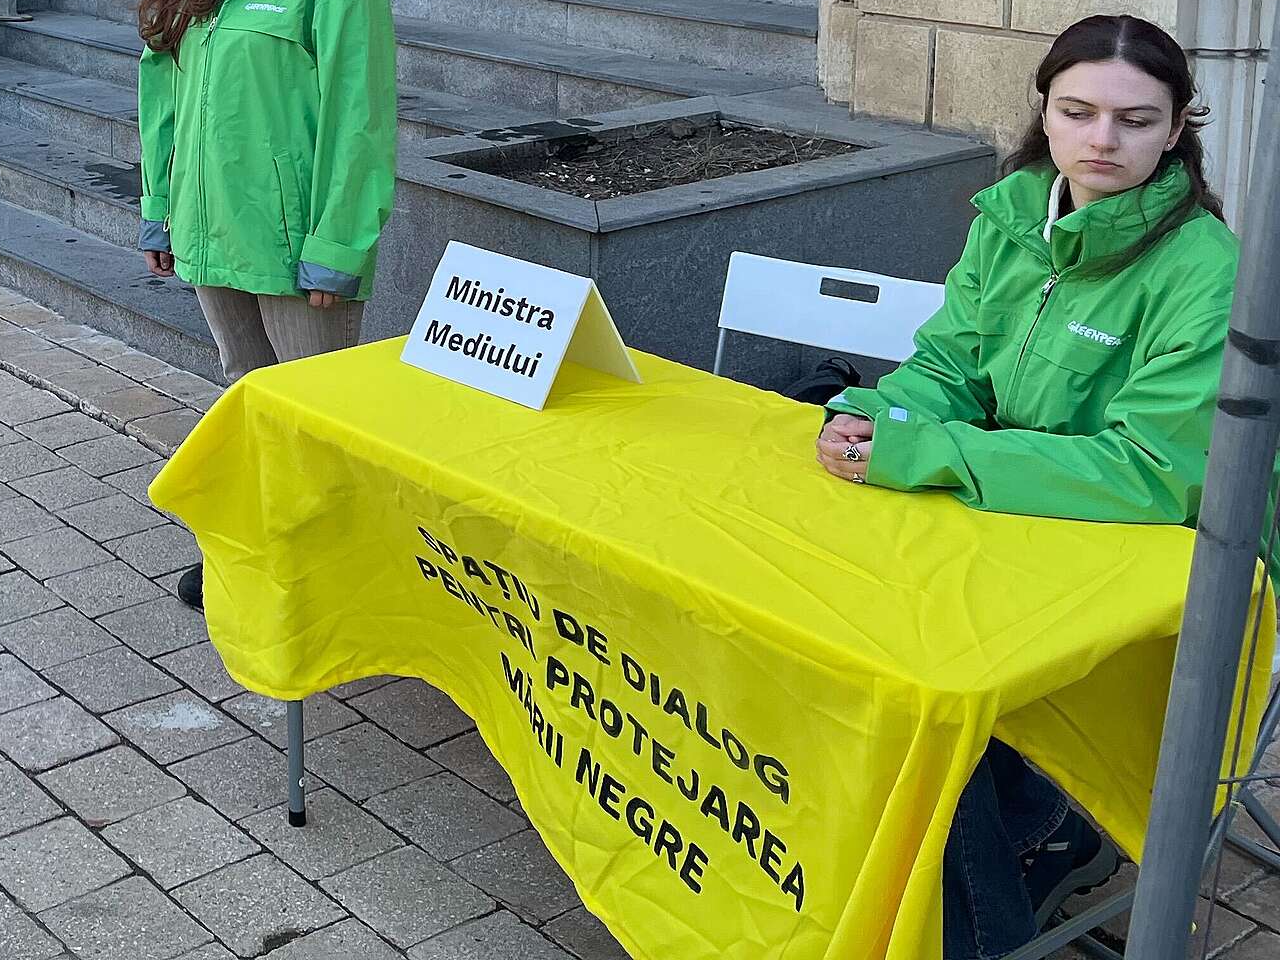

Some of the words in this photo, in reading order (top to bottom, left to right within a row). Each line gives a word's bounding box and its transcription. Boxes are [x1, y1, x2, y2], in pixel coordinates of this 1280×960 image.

[424, 319, 543, 378] Mediului
[444, 275, 555, 330] Ministra
[552, 607, 610, 666] DE
[620, 652, 790, 805] DIALOG
[546, 655, 806, 913] PROTEJAREA
[575, 747, 710, 895] NEGRE
